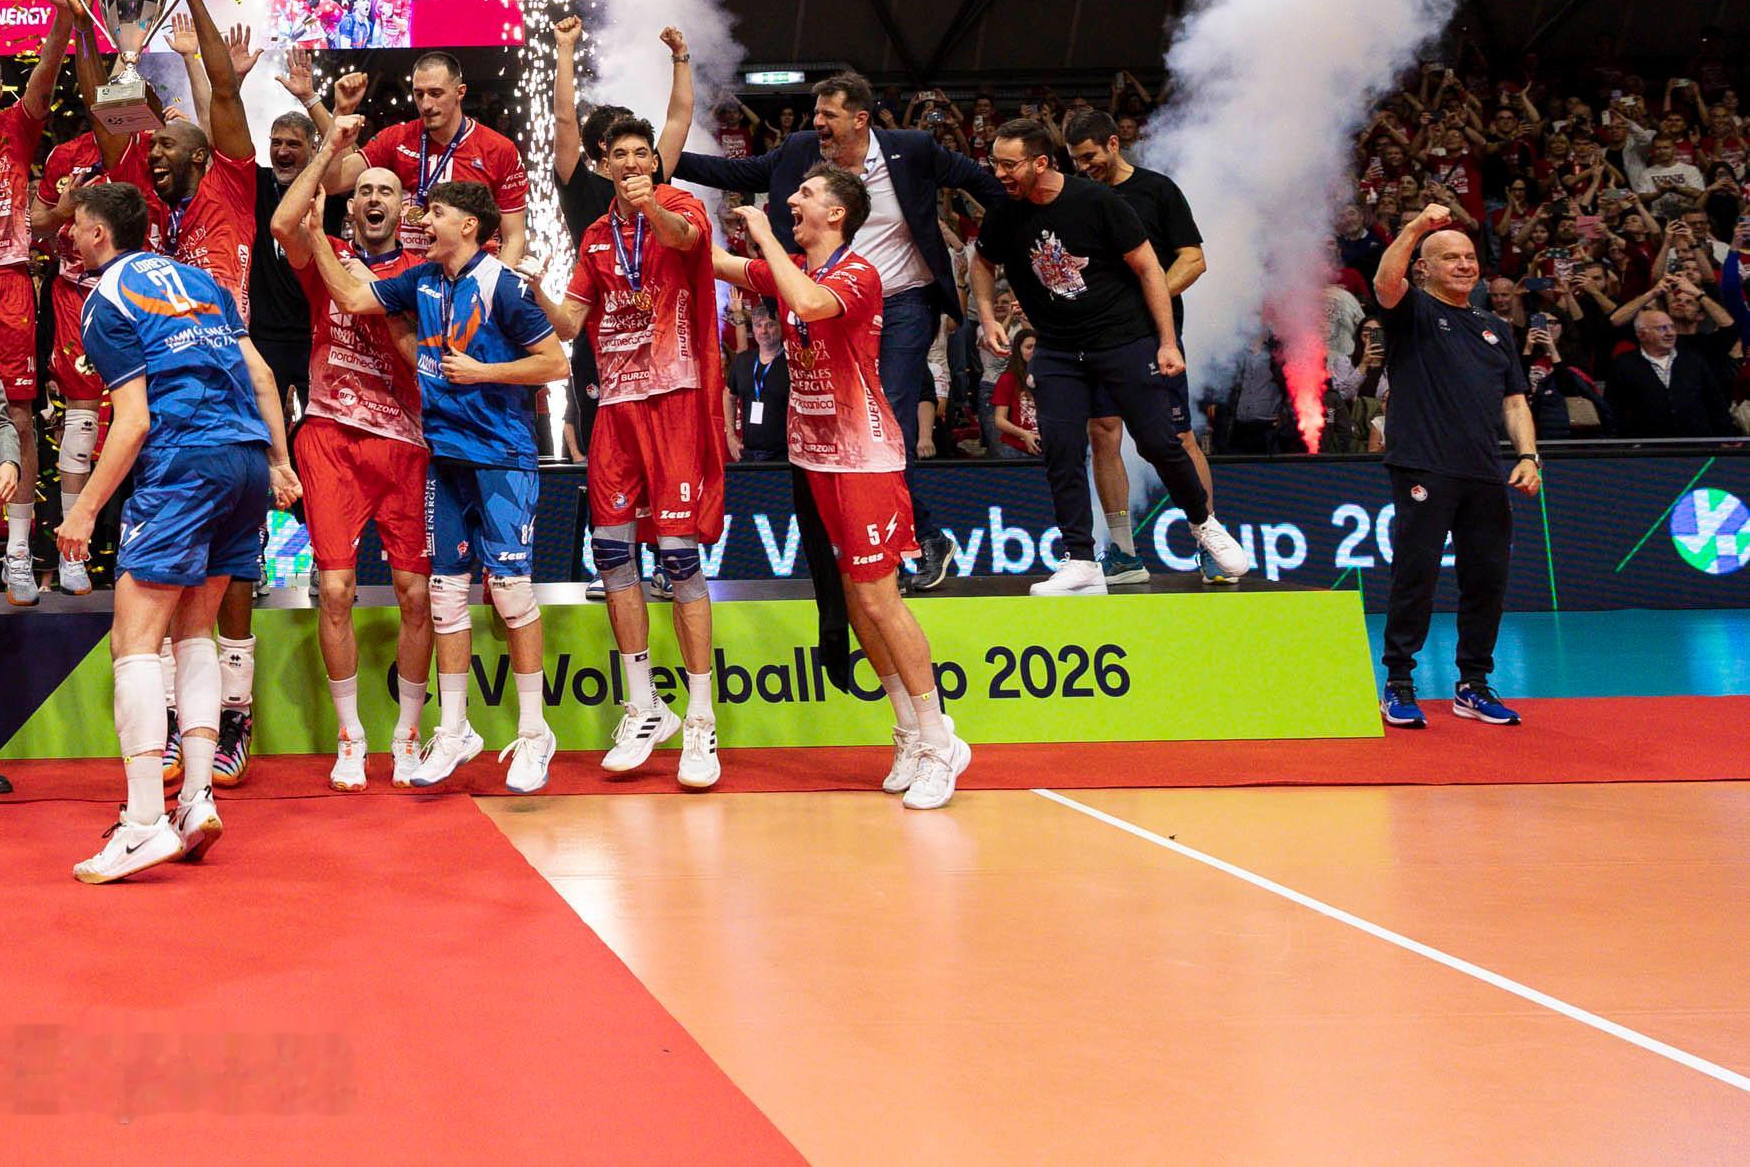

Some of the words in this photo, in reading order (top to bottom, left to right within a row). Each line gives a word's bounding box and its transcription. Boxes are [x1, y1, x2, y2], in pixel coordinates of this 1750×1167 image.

[147, 265, 198, 312] 27
[621, 371, 650, 382] BURZO
[680, 482, 691, 502] 9
[428, 479, 436, 530] ENERGIA
[660, 510, 691, 520] Zeus
[867, 524, 881, 546] 5
[498, 551, 527, 561] Zeus
[852, 552, 883, 566] Zeus
[984, 644, 1131, 700] 2026
